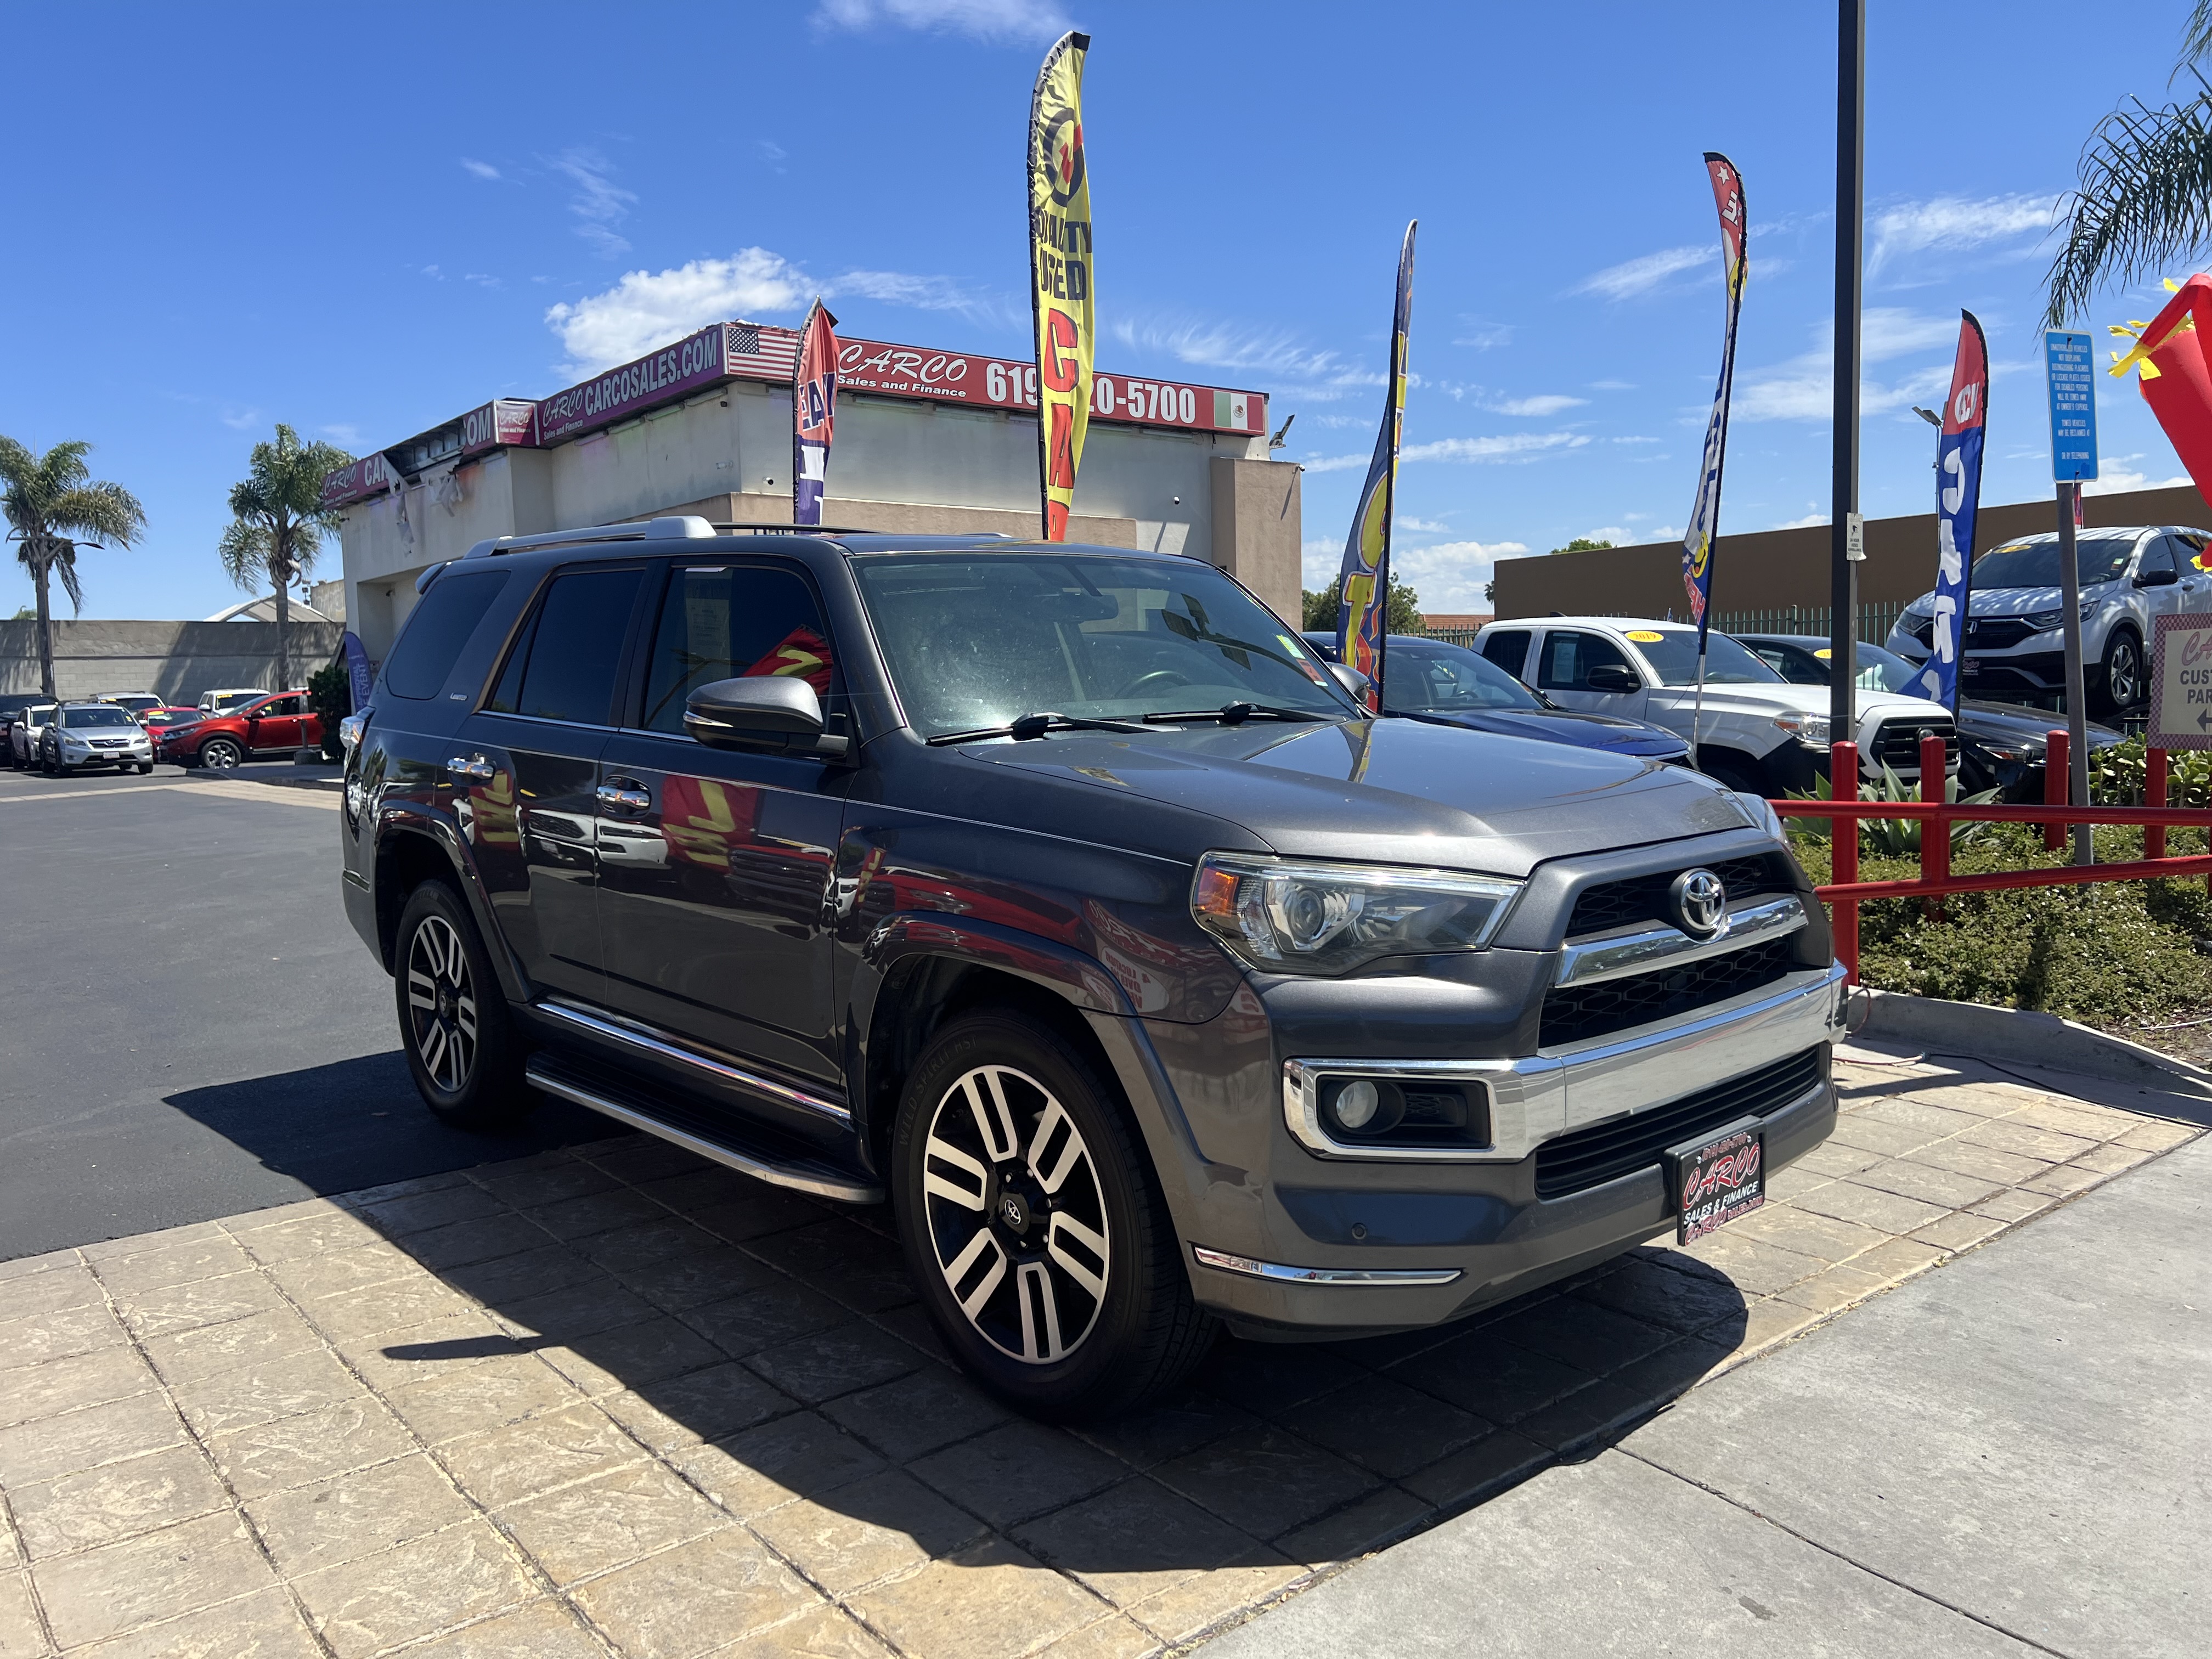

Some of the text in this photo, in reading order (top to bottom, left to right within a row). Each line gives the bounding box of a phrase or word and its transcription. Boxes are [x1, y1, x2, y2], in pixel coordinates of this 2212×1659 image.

[543, 331, 718, 428] CARCO CARCOSALES.COM
[839, 344, 968, 383] CARCO
[837, 374, 967, 398] Sales and Finance
[464, 407, 491, 447] OM
[500, 411, 529, 426] CARCO
[544, 419, 583, 441] Sales and Finance
[324, 465, 357, 497] CARCO
[358, 663, 370, 696] EVENT
[2180, 669, 2212, 685] CUS
[1683, 1142, 1761, 1211] CARCO
[1684, 1180, 1759, 1226] SALES & FINANCE
[1685, 1206, 1727, 1246] CARCO
